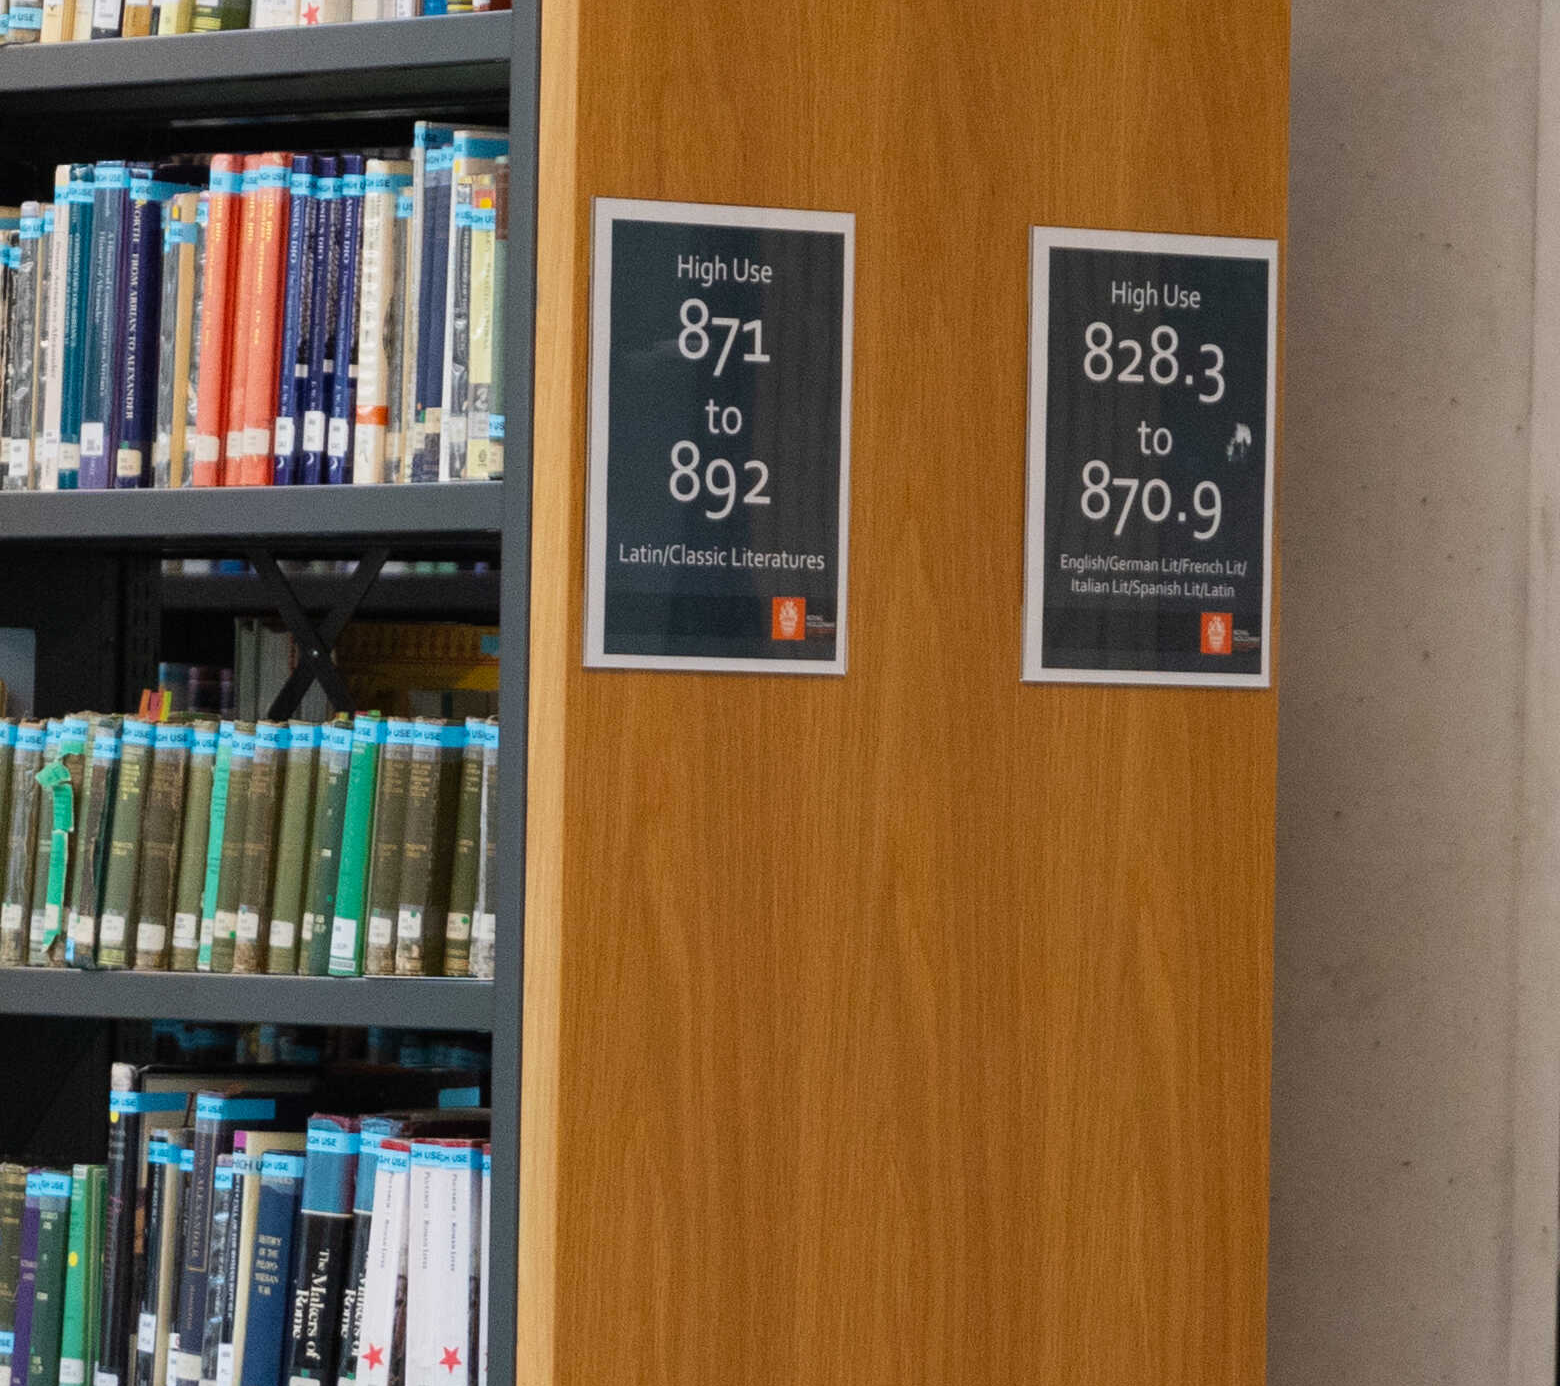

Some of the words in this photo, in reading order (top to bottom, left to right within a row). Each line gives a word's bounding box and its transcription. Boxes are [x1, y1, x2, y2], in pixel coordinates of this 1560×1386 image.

[678, 255, 726, 287] High
[734, 258, 772, 283] Use
[1112, 281, 1157, 312] High
[1164, 285, 1200, 308] Use
[678, 298, 770, 376] 871
[1084, 322, 1225, 403] 828.3
[705, 399, 742, 434] to
[1138, 421, 1172, 455] to
[669, 440, 770, 519] 892
[1081, 460, 1221, 540] 870.9
[620, 543, 726, 566] Latin/Classic
[732, 548, 824, 570] Literatures
[170, 732, 188, 743] USE
[318, 1248, 330, 1273] The
[293, 1288, 309, 1339] Rome
[307, 1273, 329, 1337] Makers
[340, 1288, 356, 1339] Rome
[305, 1339, 321, 1361] of
